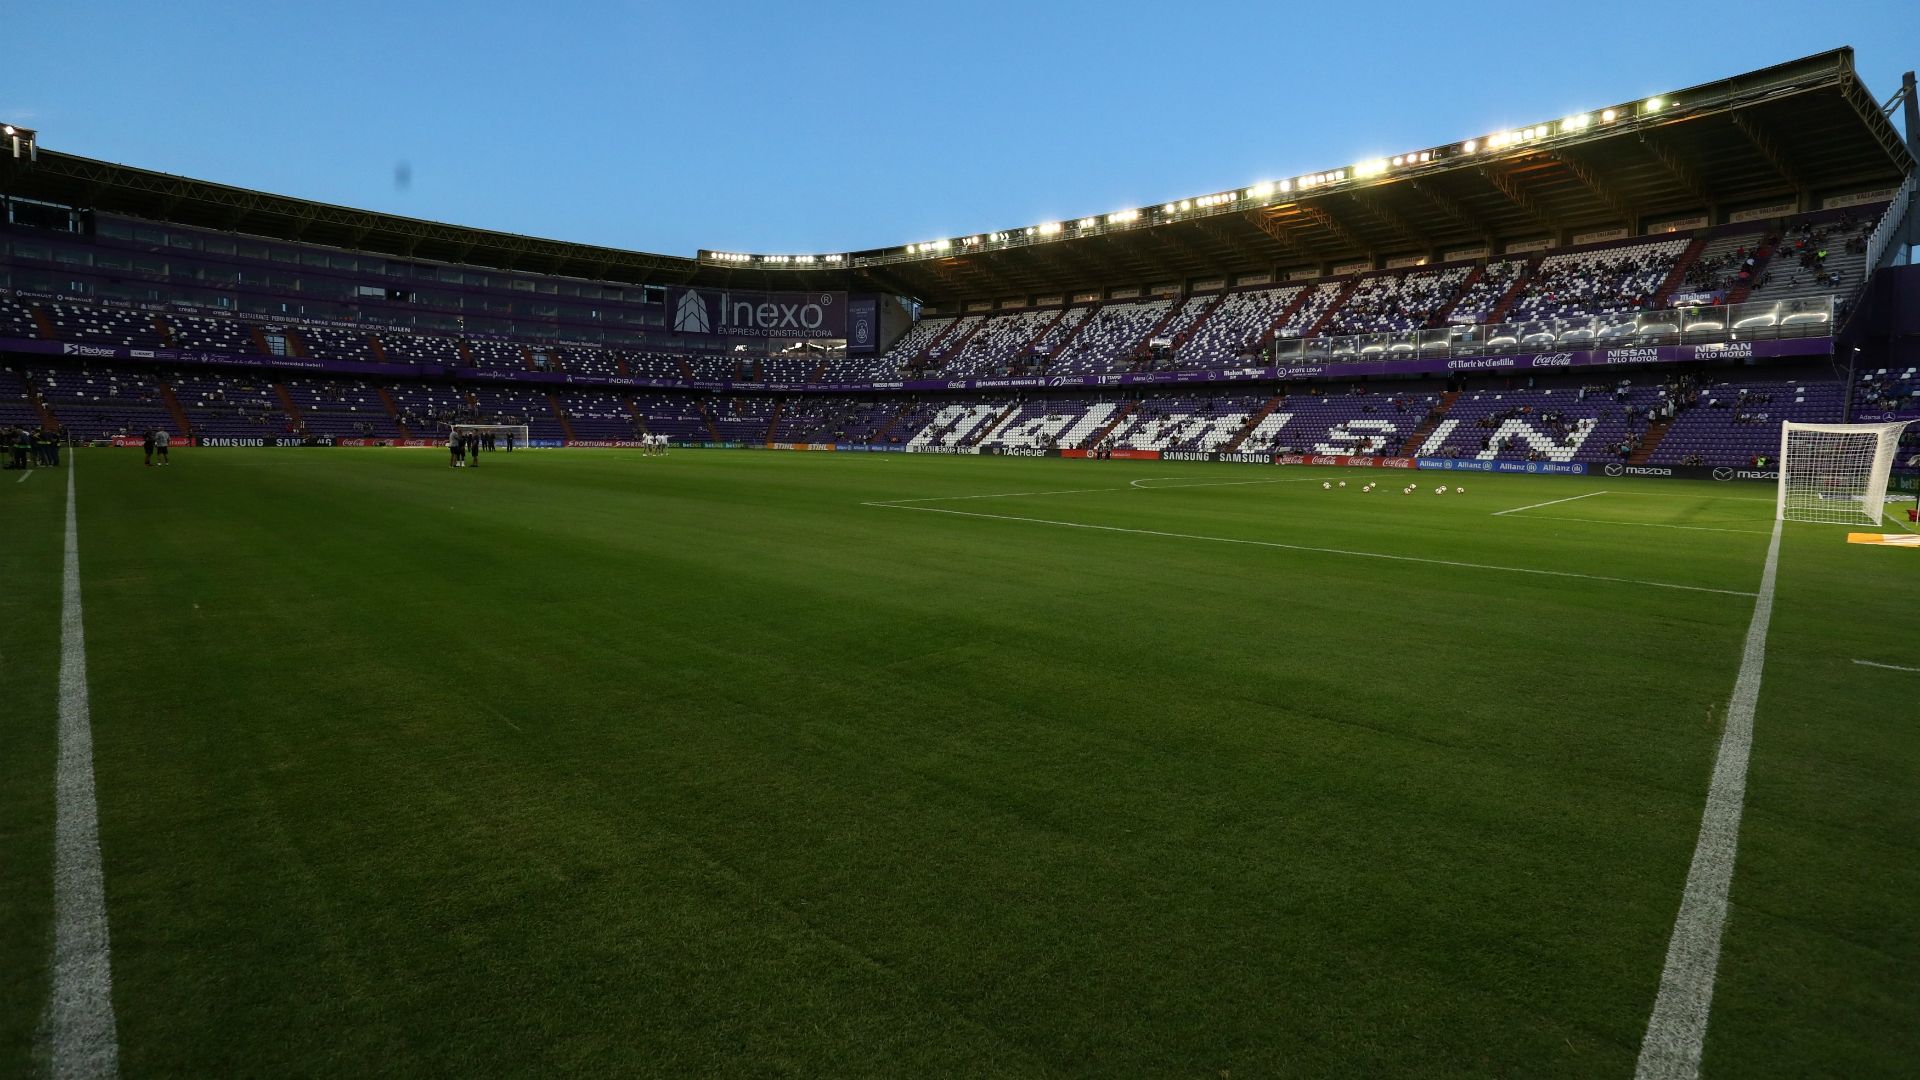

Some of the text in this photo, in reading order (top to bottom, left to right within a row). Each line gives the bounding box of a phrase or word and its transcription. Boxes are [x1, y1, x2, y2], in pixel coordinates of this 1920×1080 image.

[1679, 292, 1711, 301] Mahou
[721, 292, 823, 329] Inexo
[717, 327, 833, 338] EMPRESA CONSTRUCTORA
[80, 346, 117, 357] Redyser
[1695, 342, 1752, 353] NISSAN
[1607, 348, 1658, 358] NISSAN
[1695, 350, 1753, 360] EYLO MOTOR
[1447, 356, 1515, 369] El Norte de Castilla
[1532, 352, 1574, 367] Coca-Cola
[1607, 355, 1659, 364] EYLO MOTOR
[202, 437, 264, 447] SAMSUNG
[773, 442, 795, 450] STIHL
[807, 443, 829, 451] STIHL
[1163, 451, 1210, 462] SAMSUNG
[1219, 453, 1270, 463] SAMSUNG
[1311, 455, 1337, 465] Coca-Cola
[1347, 456, 1374, 467] Coca-Cola
[1382, 457, 1410, 468] Coca-Cola
[1419, 459, 1443, 467] Allianz
[1457, 460, 1481, 469] Allianz
[1499, 462, 1525, 471] Allianz
[1542, 464, 1571, 472] Allianz
[1625, 465, 1672, 476] mazda
